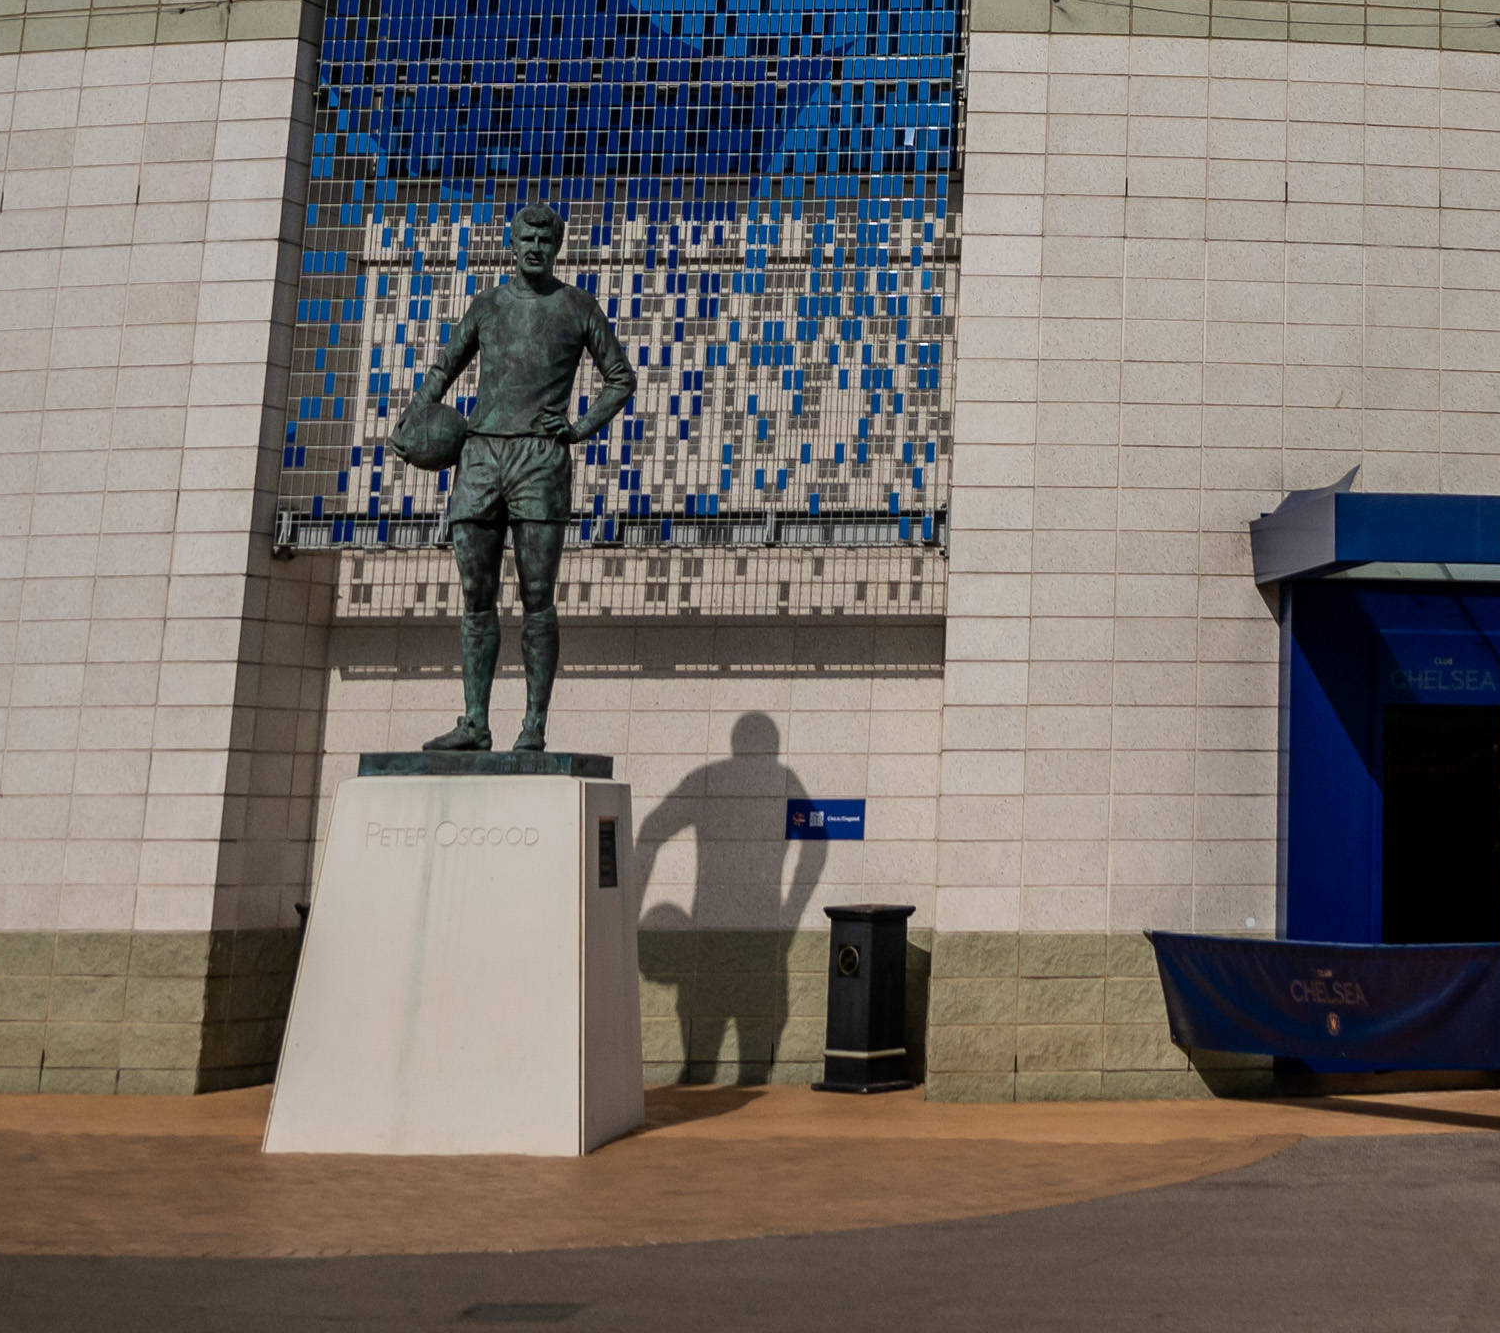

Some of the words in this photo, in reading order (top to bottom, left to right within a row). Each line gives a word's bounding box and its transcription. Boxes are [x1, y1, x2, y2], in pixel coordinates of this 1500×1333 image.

[1390, 669, 1497, 692] CHELSEA
[365, 821, 428, 848] PETER
[435, 820, 540, 848] OSGOOD
[1289, 979, 1369, 1007] CHELSEA
